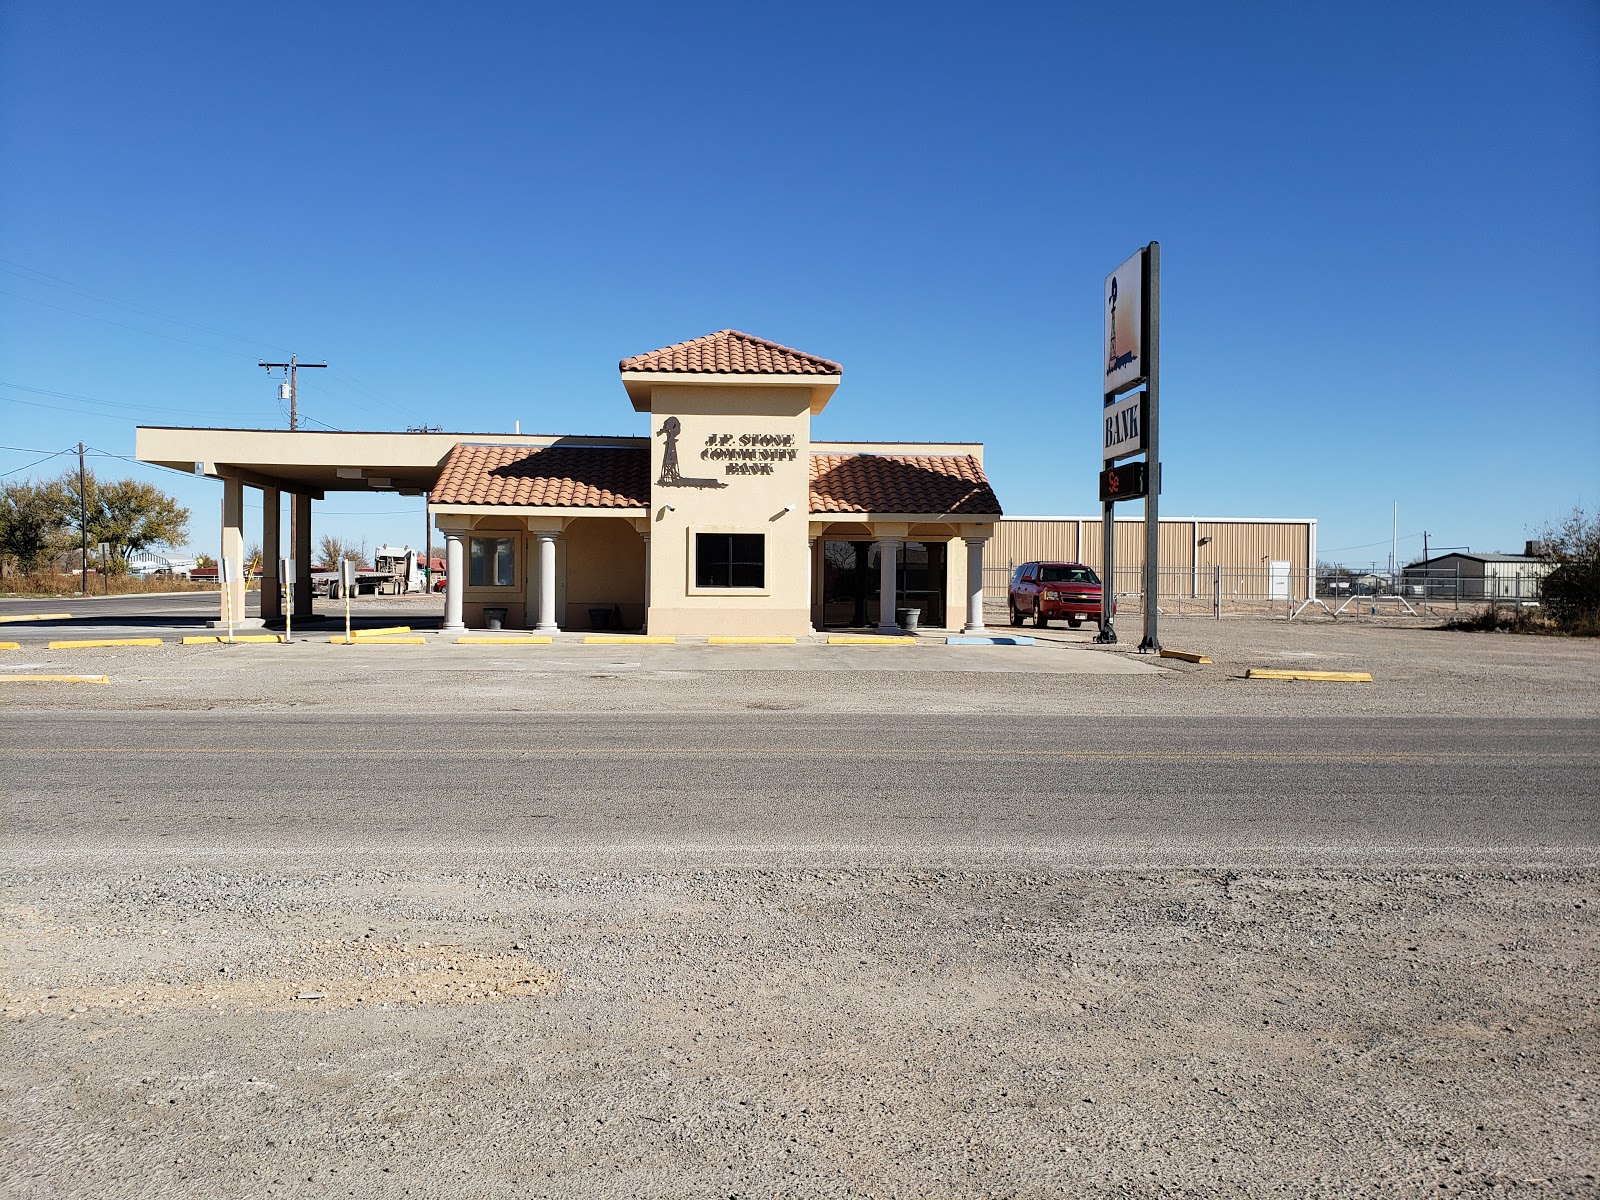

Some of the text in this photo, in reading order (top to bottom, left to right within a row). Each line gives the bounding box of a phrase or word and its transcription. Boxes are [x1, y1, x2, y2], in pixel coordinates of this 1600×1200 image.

[1105, 404, 1138, 448] BANK
[705, 433, 795, 447] J.P. STONE
[700, 448, 799, 461] COMMUNITY
[725, 462, 775, 475] BANK
